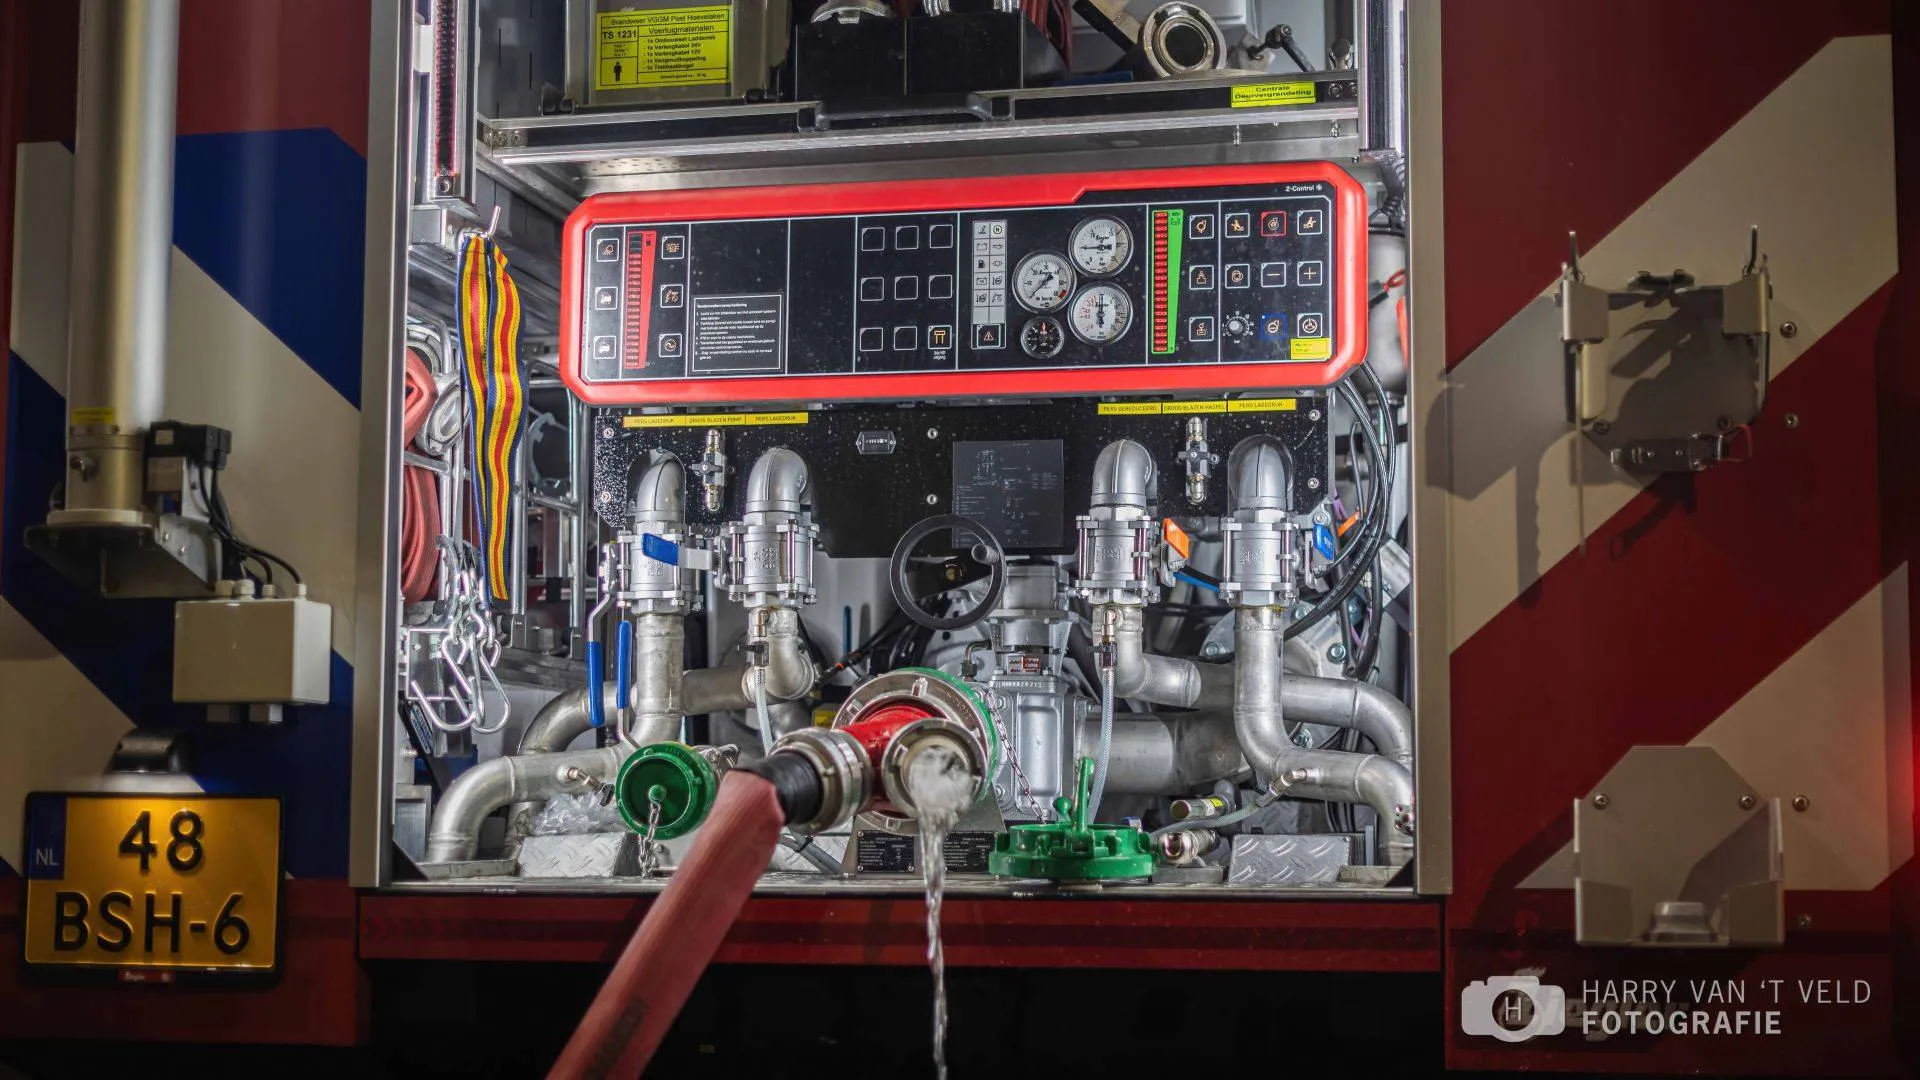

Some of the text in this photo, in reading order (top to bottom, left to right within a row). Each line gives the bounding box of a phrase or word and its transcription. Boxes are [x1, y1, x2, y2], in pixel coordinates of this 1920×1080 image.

[611, 18, 646, 26] Brandweer
[688, 13, 725, 21] Hoevelaken
[602, 30, 637, 39] TS 1231
[648, 25, 715, 35] Voertuigmaterialen
[1234, 90, 1312, 99] Deurvergrendeling
[1285, 184, 1315, 192] Z-Control
[118, 810, 205, 872] 48
[35, 849, 60, 866] NL
[54, 890, 250, 955] BSH-6
